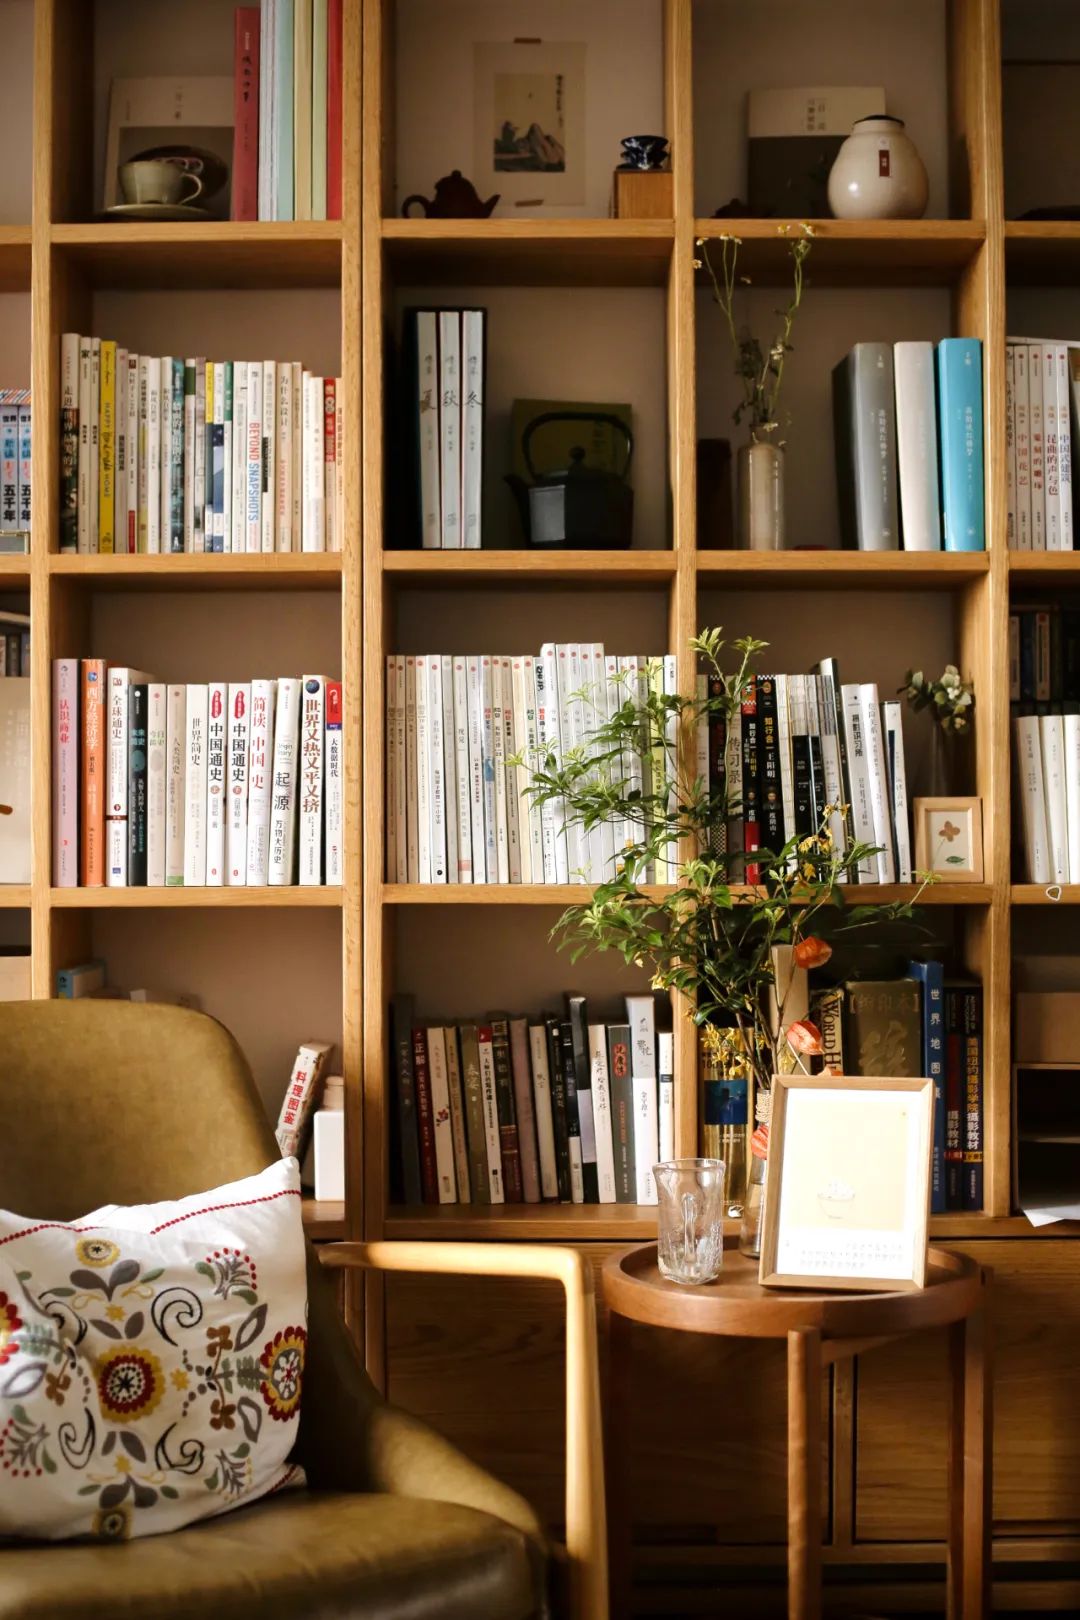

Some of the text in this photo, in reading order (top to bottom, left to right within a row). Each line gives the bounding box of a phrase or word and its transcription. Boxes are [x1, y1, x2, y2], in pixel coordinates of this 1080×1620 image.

[248, 422, 260, 522] BEYOND SNAPSHOTS
[3, 484, 16, 522] 五千年
[21, 484, 31, 522] 五千年
[86, 687, 98, 750] 西方经济学
[112, 695, 122, 739] 全球通史
[749, 723, 757, 749] 知行合一
[191, 718, 202, 766] 世界简史
[209, 722, 223, 781] 中国通史
[231, 723, 245, 782] 中国通史
[303, 699, 320, 813] 世界又热又平又挤
[330, 737, 339, 778] 大数据时代
[729, 737, 741, 784] 传习录
[764, 717, 776, 778] 知行合一 王阳明
[274, 771, 290, 811] 起源
[273, 820, 283, 865] 万物大历史
[823, 998, 840, 1050] WORLD
